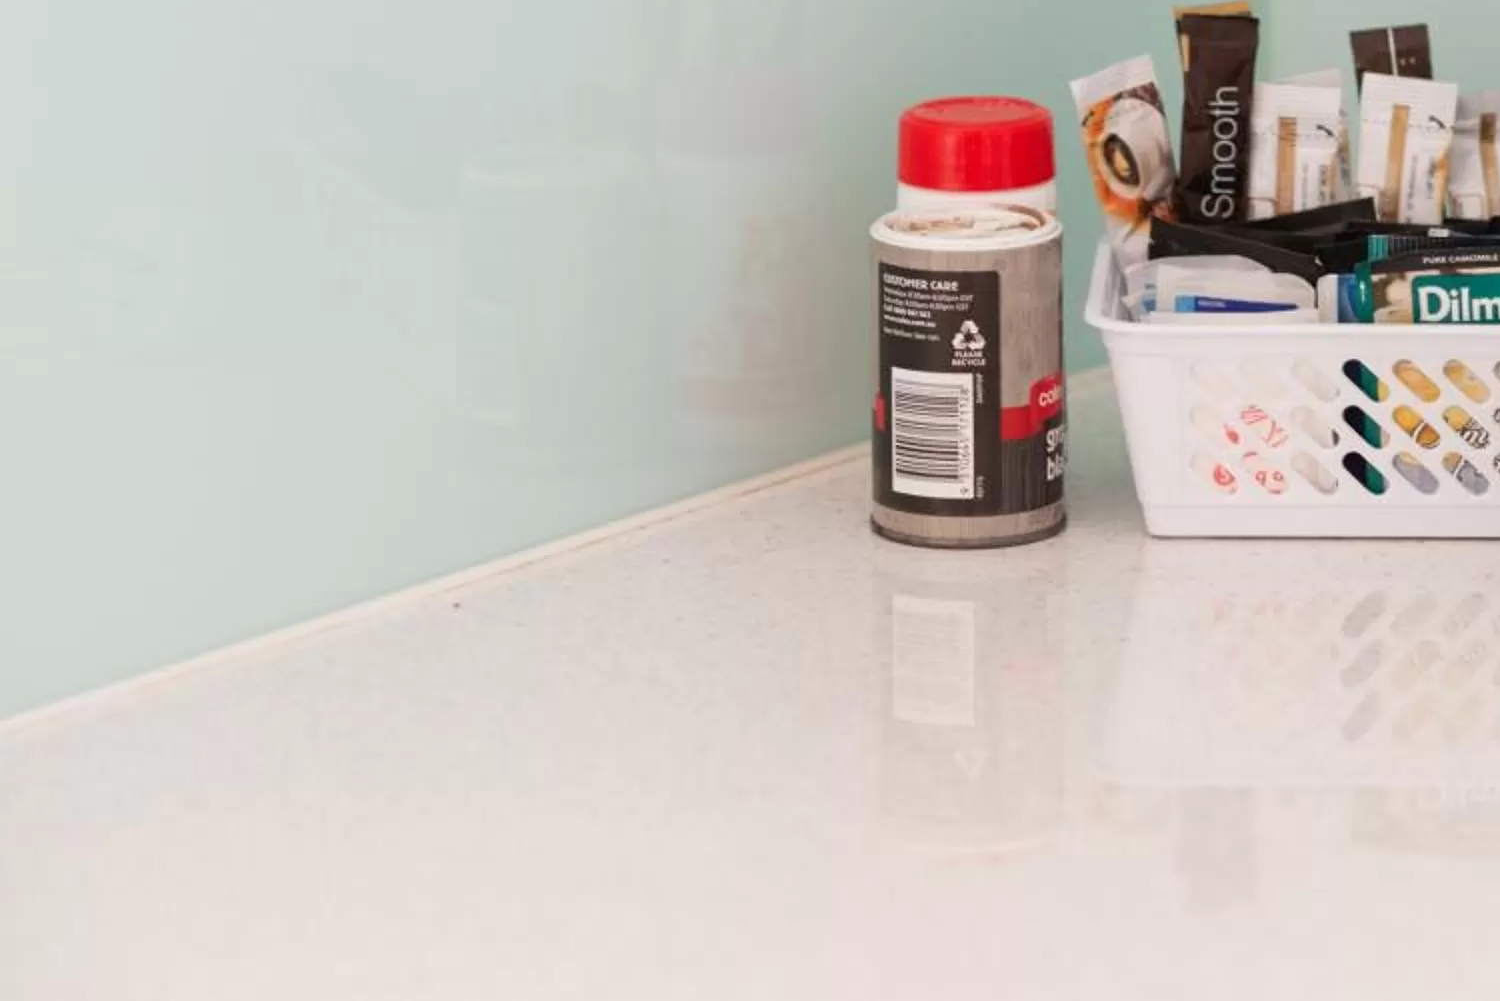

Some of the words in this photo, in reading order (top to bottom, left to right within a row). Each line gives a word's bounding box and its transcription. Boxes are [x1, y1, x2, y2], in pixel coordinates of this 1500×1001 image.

[1200, 86, 1240, 218] Smooth
[883, 273, 928, 291] CUSTOMER
[930, 280, 960, 292] CARE
